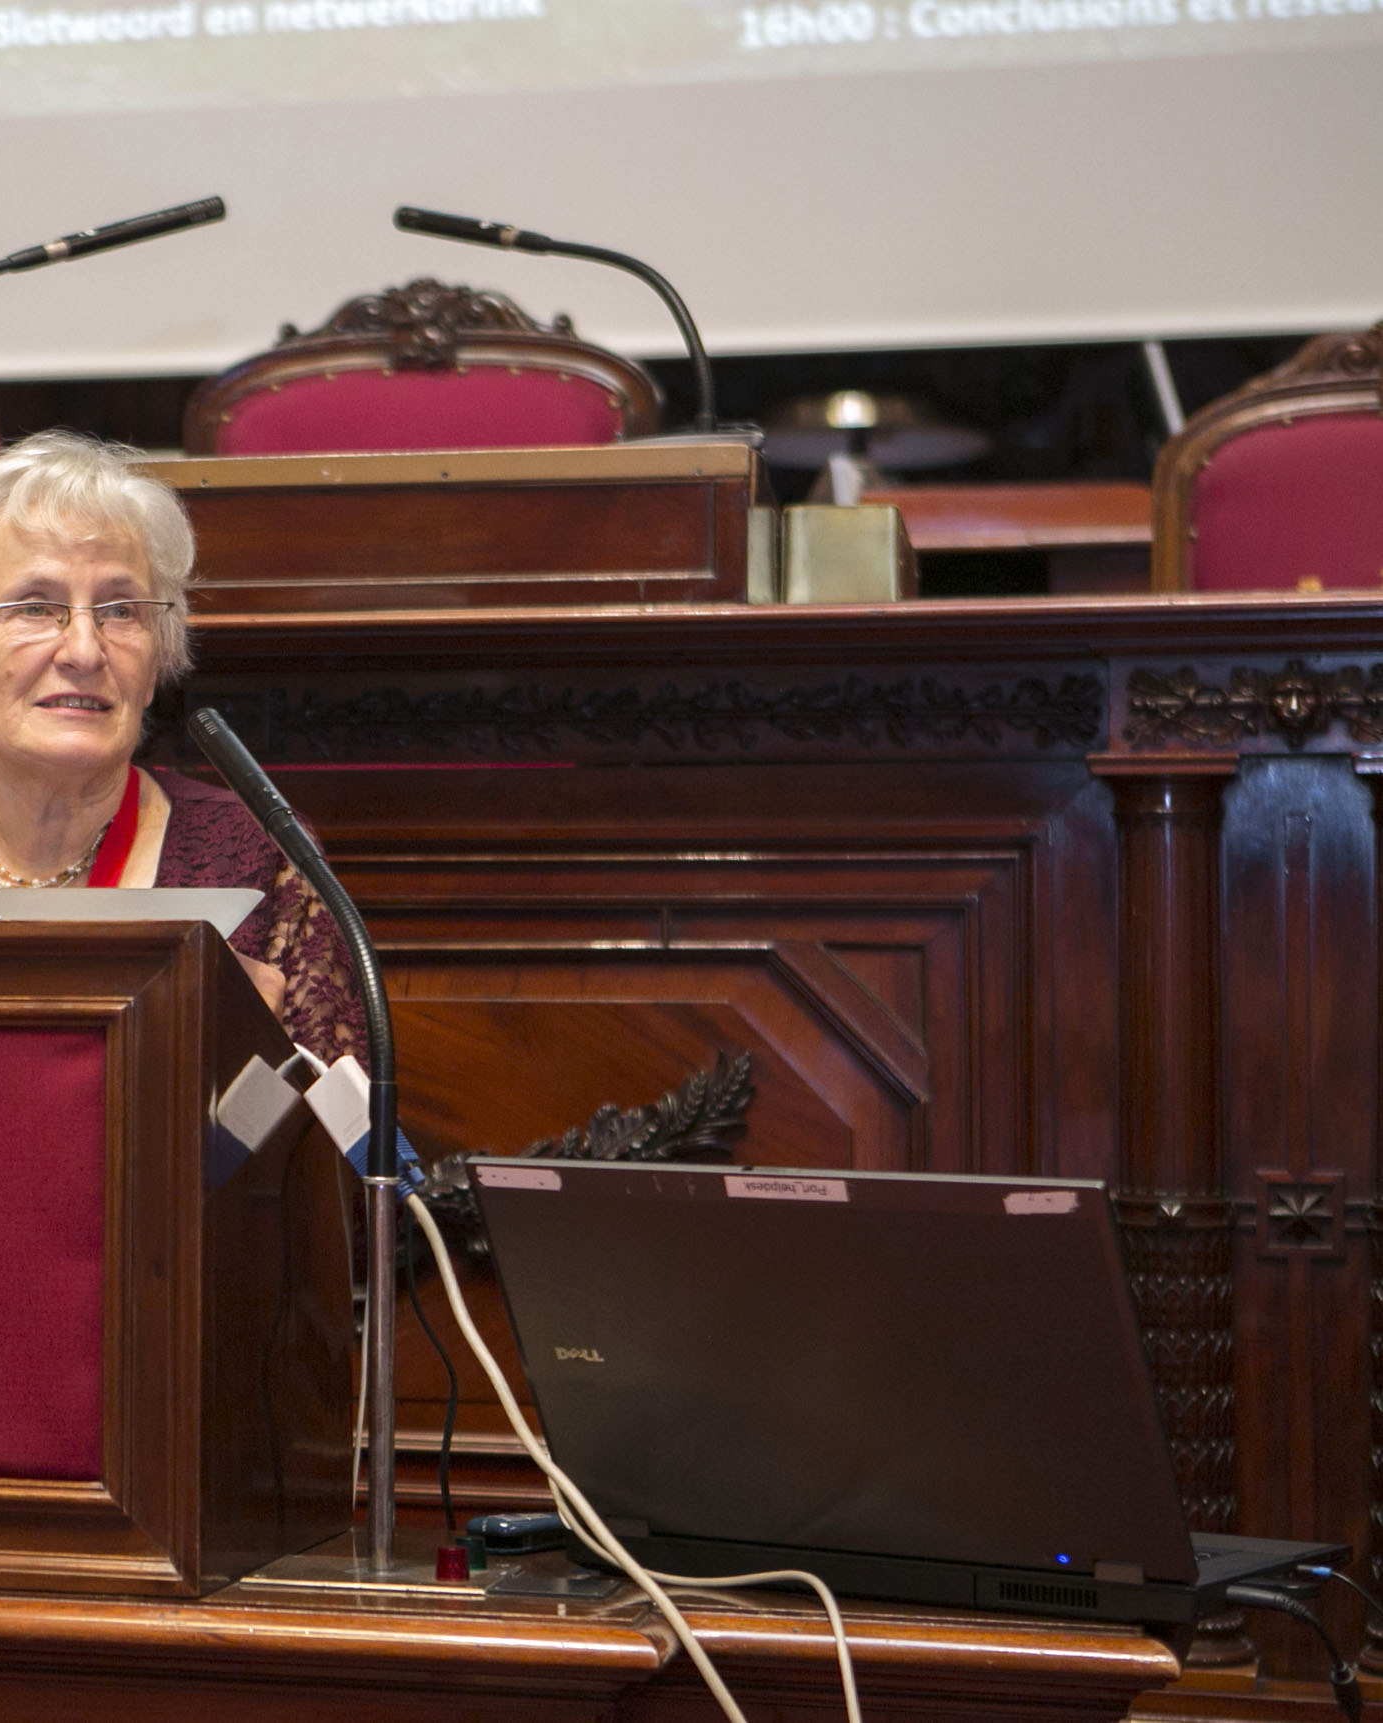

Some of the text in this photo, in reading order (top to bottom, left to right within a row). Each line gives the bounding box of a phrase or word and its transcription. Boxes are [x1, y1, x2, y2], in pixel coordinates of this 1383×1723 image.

[203, 6, 259, 37] en
[739, 1, 874, 48] 16h00
[908, 0, 1176, 38] Conclusions
[554, 1346, 606, 1363] DELL
